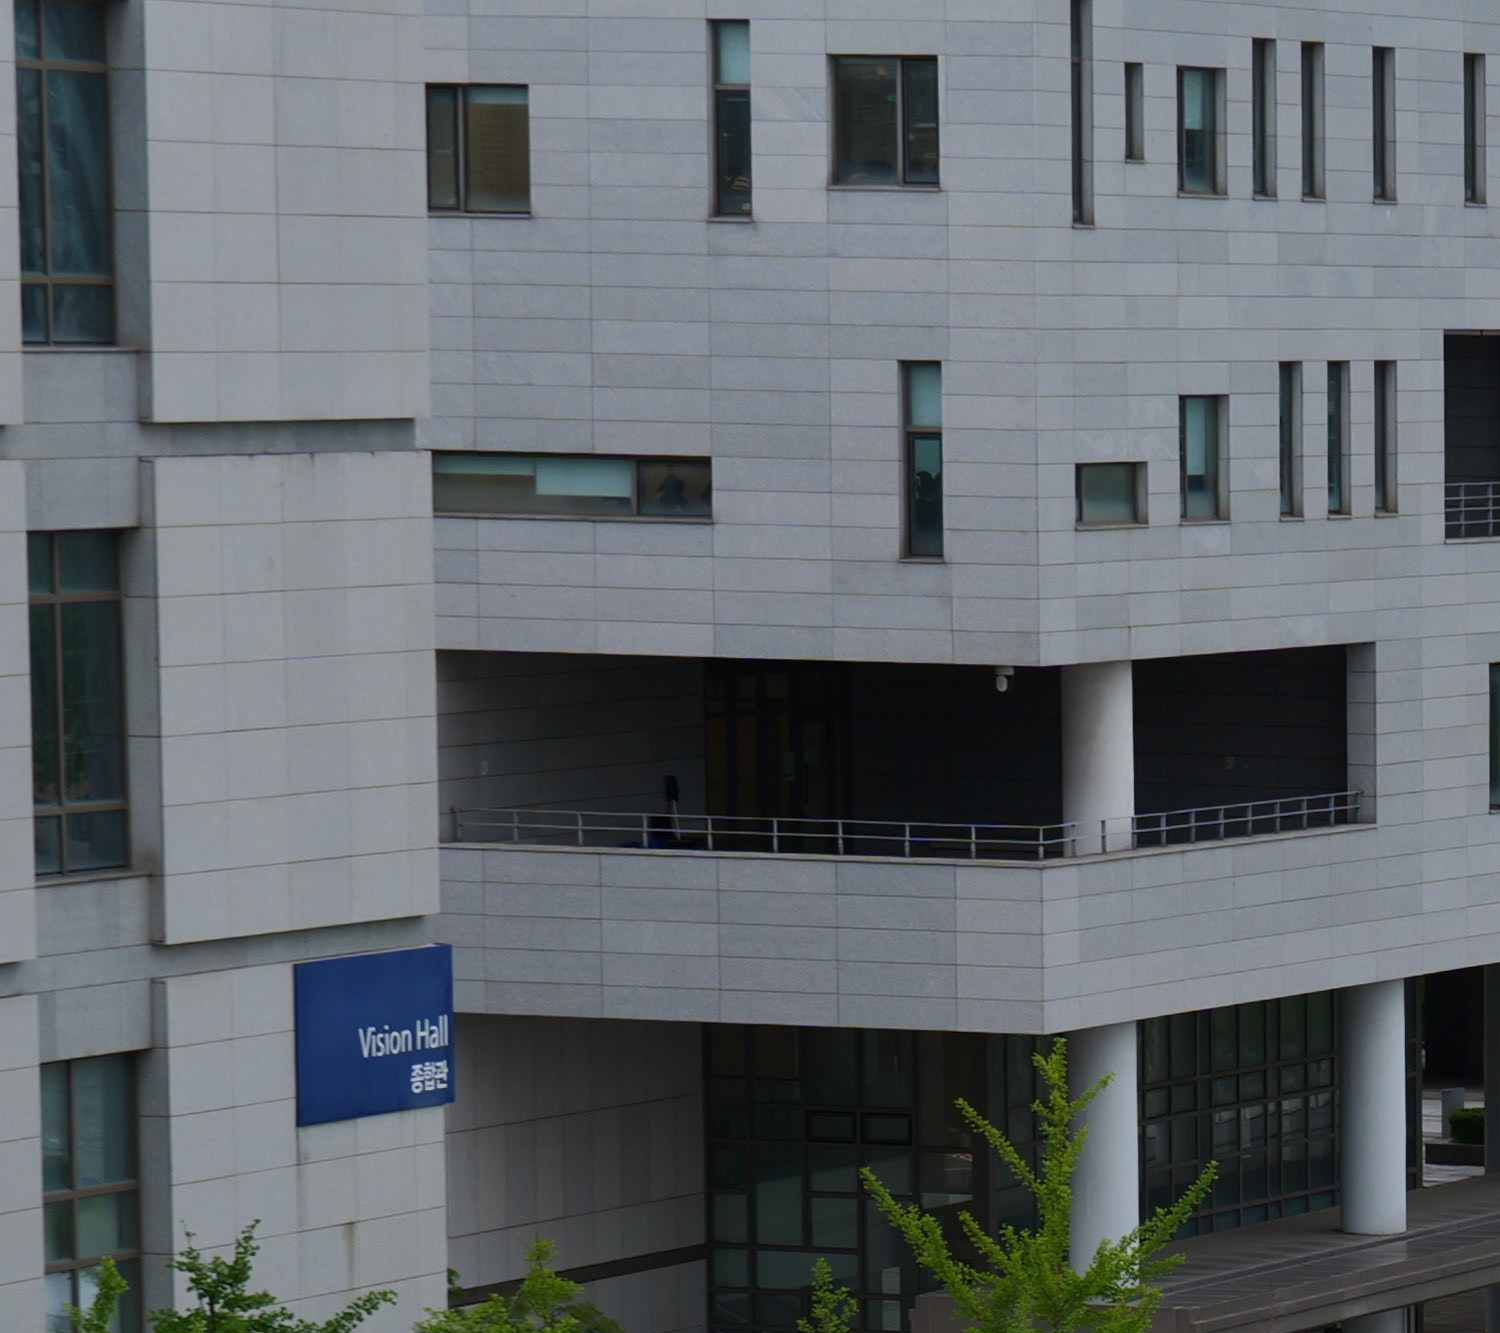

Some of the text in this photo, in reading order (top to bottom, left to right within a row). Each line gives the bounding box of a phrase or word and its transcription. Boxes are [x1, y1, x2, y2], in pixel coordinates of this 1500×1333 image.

[358, 1014, 449, 1058] Vision Hall
[410, 1060, 448, 1093] 종합관
